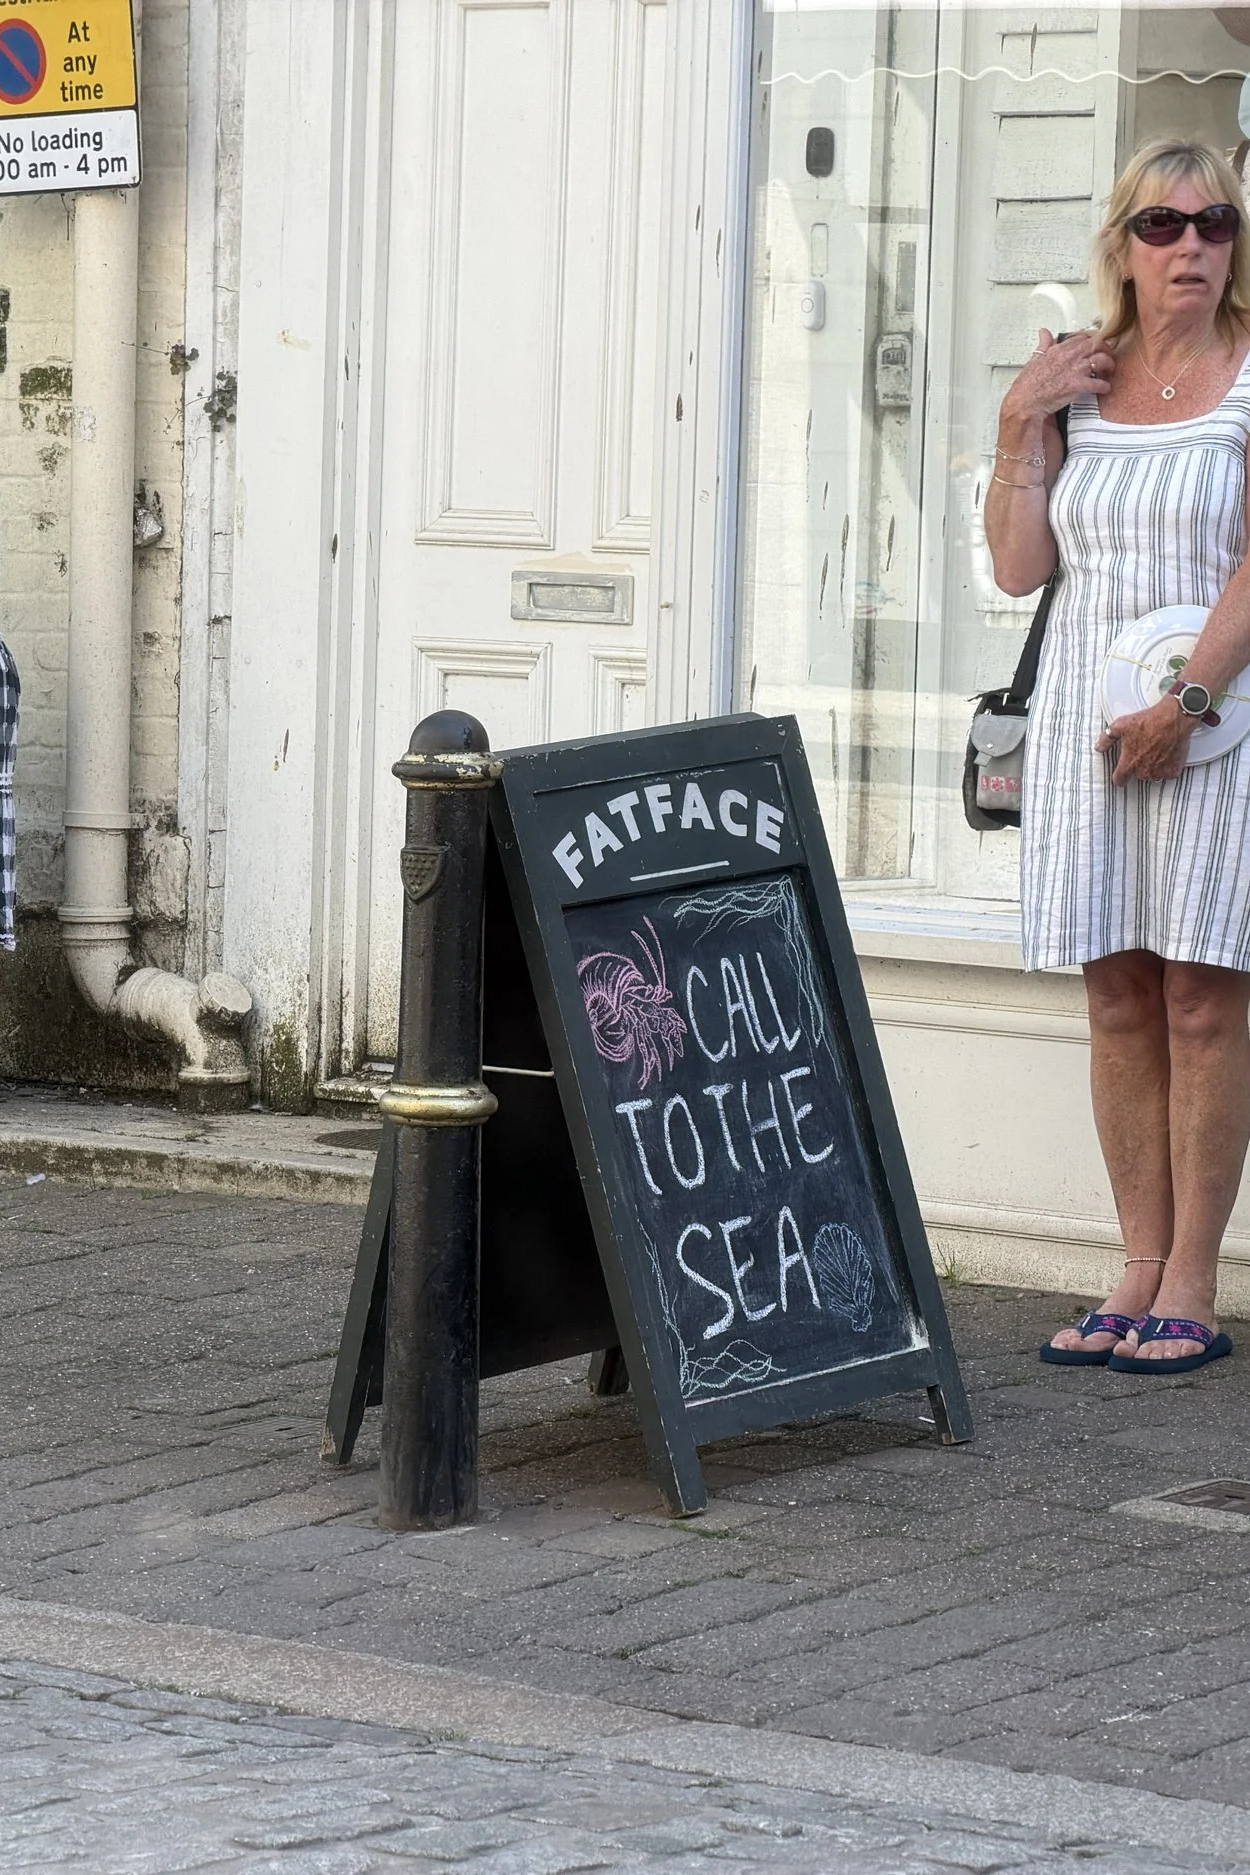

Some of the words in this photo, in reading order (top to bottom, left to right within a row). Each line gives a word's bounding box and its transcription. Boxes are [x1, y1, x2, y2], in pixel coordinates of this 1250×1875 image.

[67, 20, 91, 43] At
[63, 54, 97, 75] any
[60, 81, 103, 102] time
[31, 128, 103, 151] loading
[28, 161, 56, 178] am
[76, 153, 90, 175] 4
[97, 155, 128, 178] pm
[552, 782, 785, 889] FATFACE
[686, 952, 800, 1063] CALL
[676, 1205, 821, 1340] SEA
